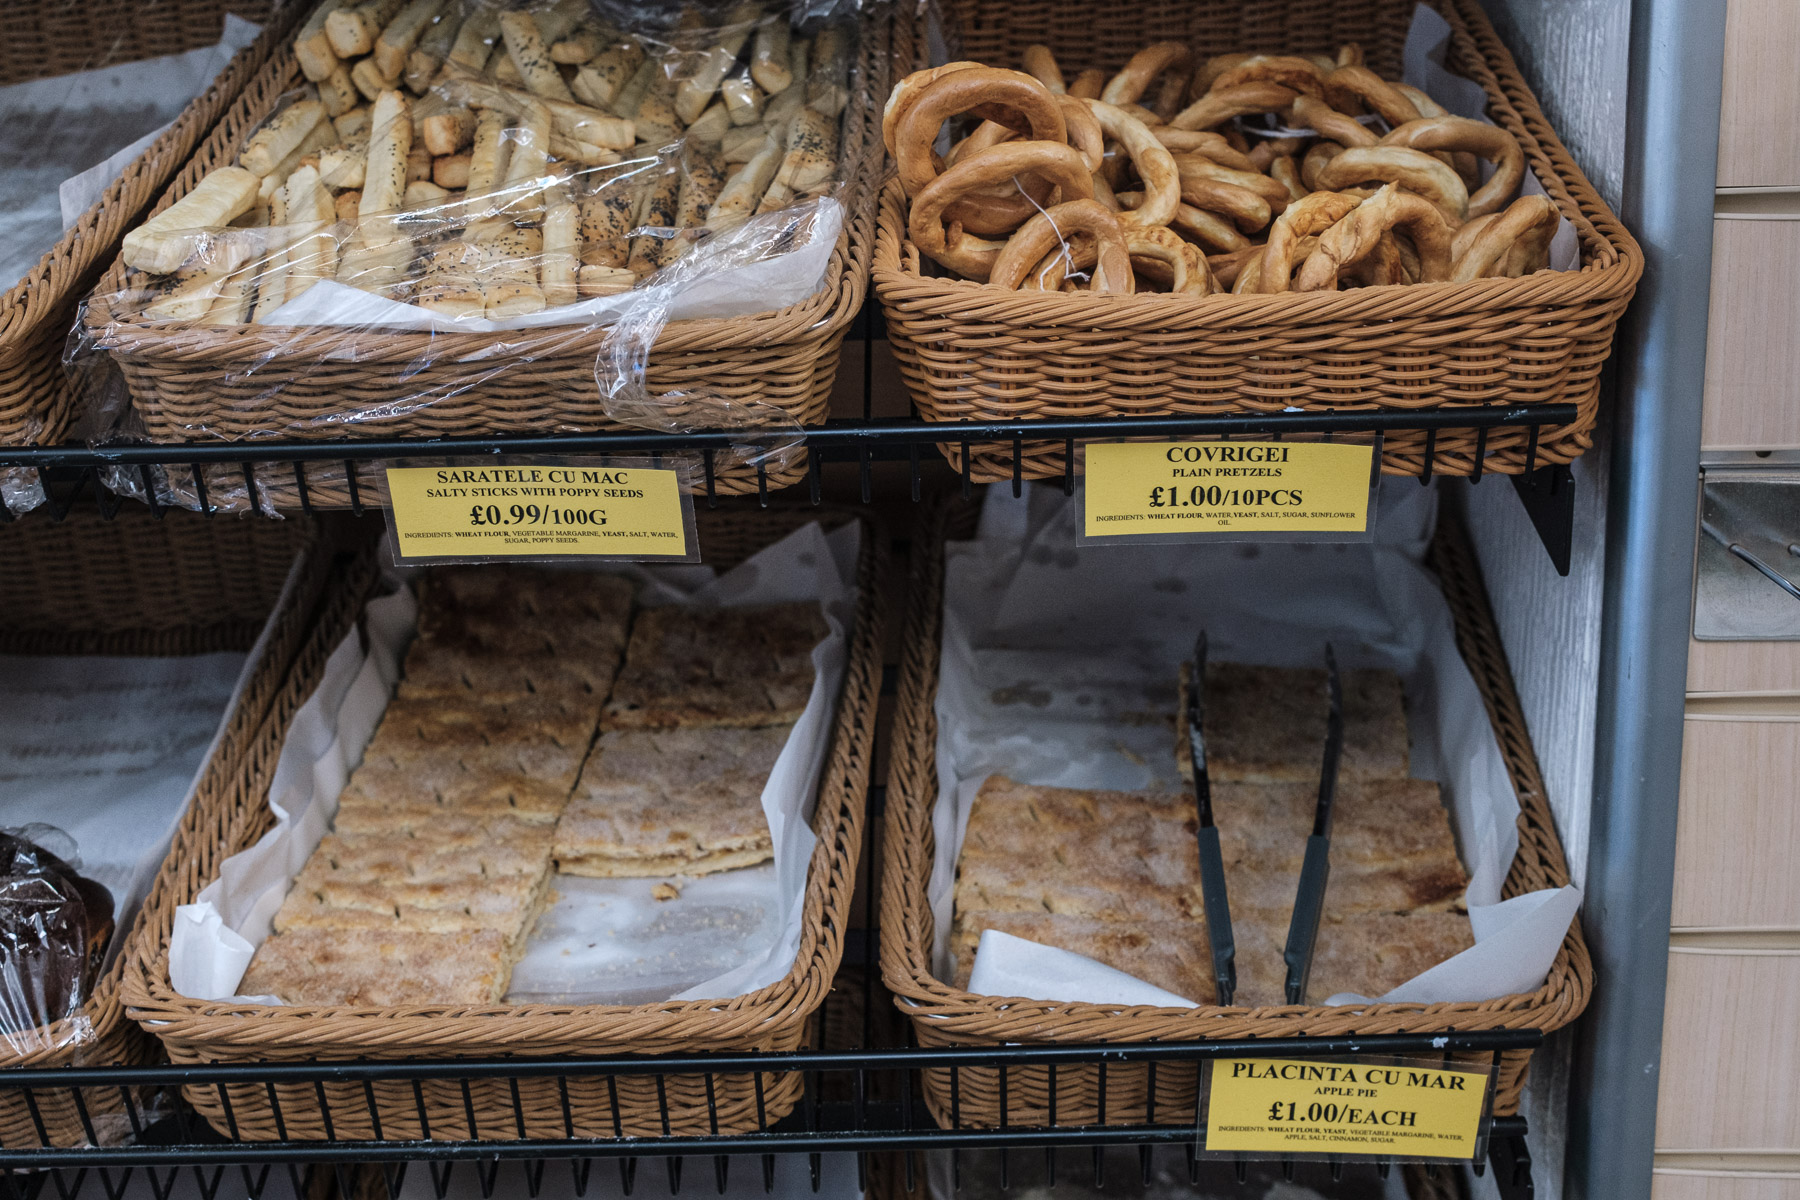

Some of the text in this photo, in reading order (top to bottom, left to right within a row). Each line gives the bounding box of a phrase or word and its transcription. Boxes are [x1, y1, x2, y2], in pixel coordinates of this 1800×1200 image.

[1166, 447, 1289, 463] COVRIGEI
[437, 470, 628, 485] SARATELE CU MAC
[1172, 468, 1282, 477] PLAIN PRETZELS
[427, 488, 643, 498] SALTY STICKS WITH POPPY SEEDS
[1149, 486, 1303, 507] £1.00/10PCS
[470, 504, 608, 525] £0.99/100G
[650, 531, 678, 539] WATER,
[1232, 1063, 1465, 1090] PLACINTA CU MAR
[1314, 1087, 1378, 1097] APPLE PIE
[1268, 1102, 1417, 1126] £1.00/EACH
[1437, 1133, 1464, 1142] WATER,
